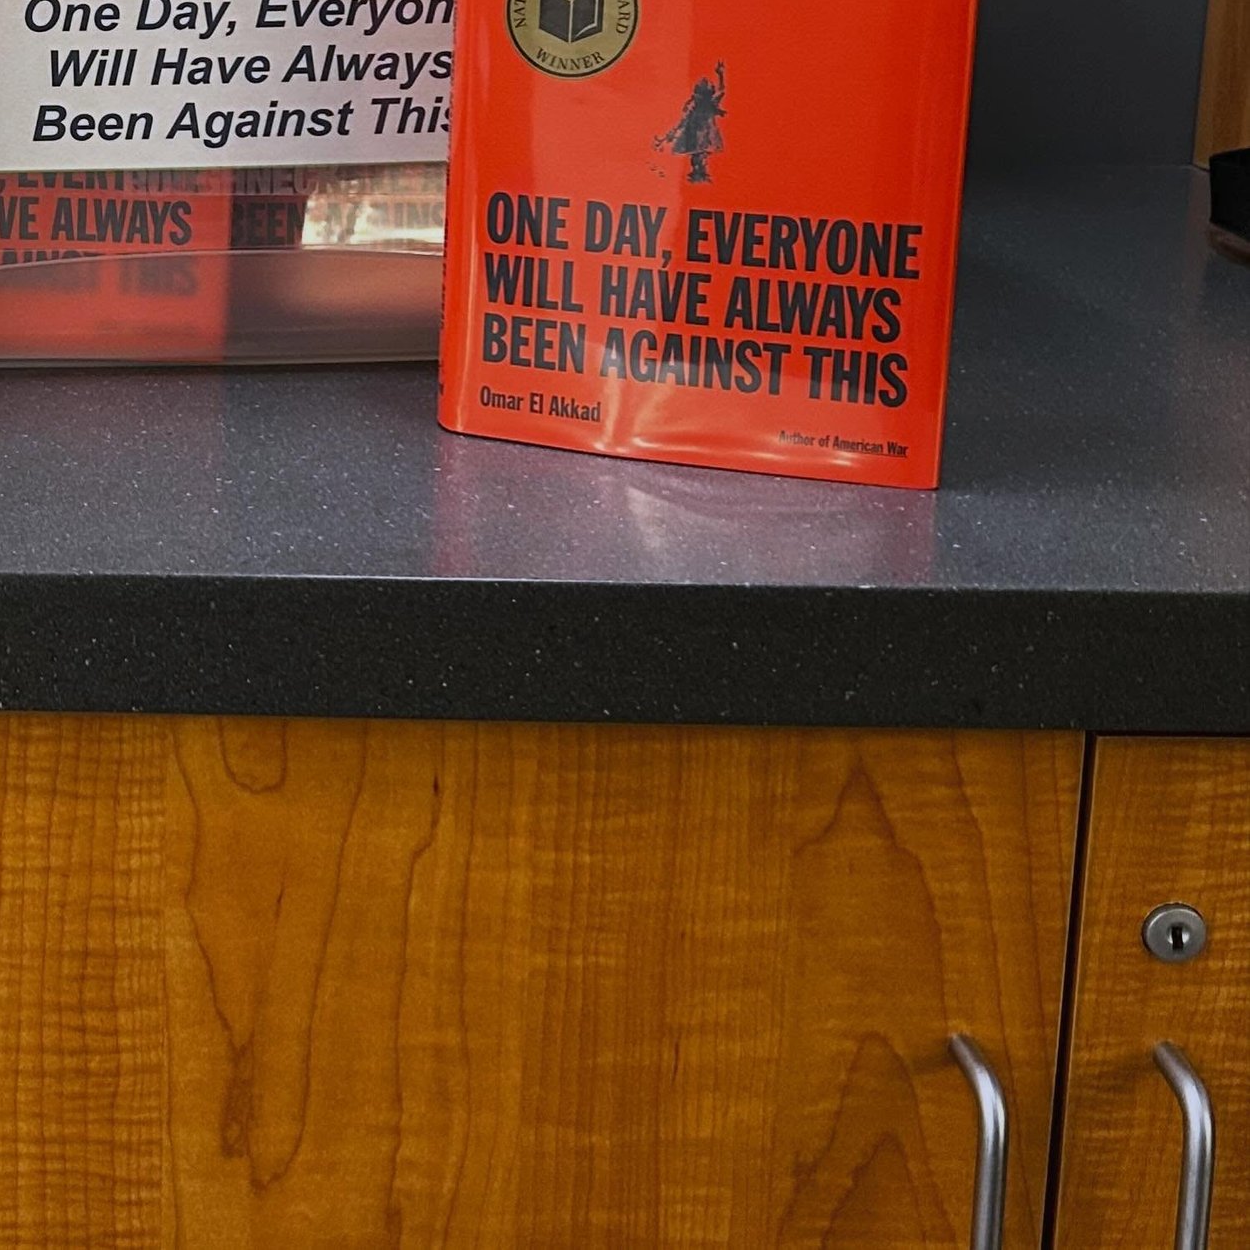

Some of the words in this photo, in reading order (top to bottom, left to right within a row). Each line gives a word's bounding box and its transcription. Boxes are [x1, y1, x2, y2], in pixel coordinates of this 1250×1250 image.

[50, 49, 136, 87] Will
[151, 48, 270, 85] Have
[283, 45, 452, 90] Always
[536, 47, 605, 70] WINNER
[33, 104, 152, 141] Been
[167, 100, 353, 148] Against
[51, 197, 193, 246] ALWAYS
[487, 192, 570, 249] ONE
[584, 201, 671, 266] DAY,
[687, 209, 923, 279] EVERYONE
[484, 252, 583, 312] WILL
[601, 264, 712, 326] HAVE
[724, 276, 902, 344] ALWAYS
[482, 313, 585, 374] BEEN
[600, 328, 791, 395] AGAINST
[804, 346, 908, 407] THIS
[480, 385, 524, 412] Omar
[529, 392, 544, 415] El
[549, 397, 601, 423] Akkad
[778, 430, 815, 446] Author
[819, 435, 830, 447] of
[833, 435, 883, 453] American
[887, 441, 909, 457] War
